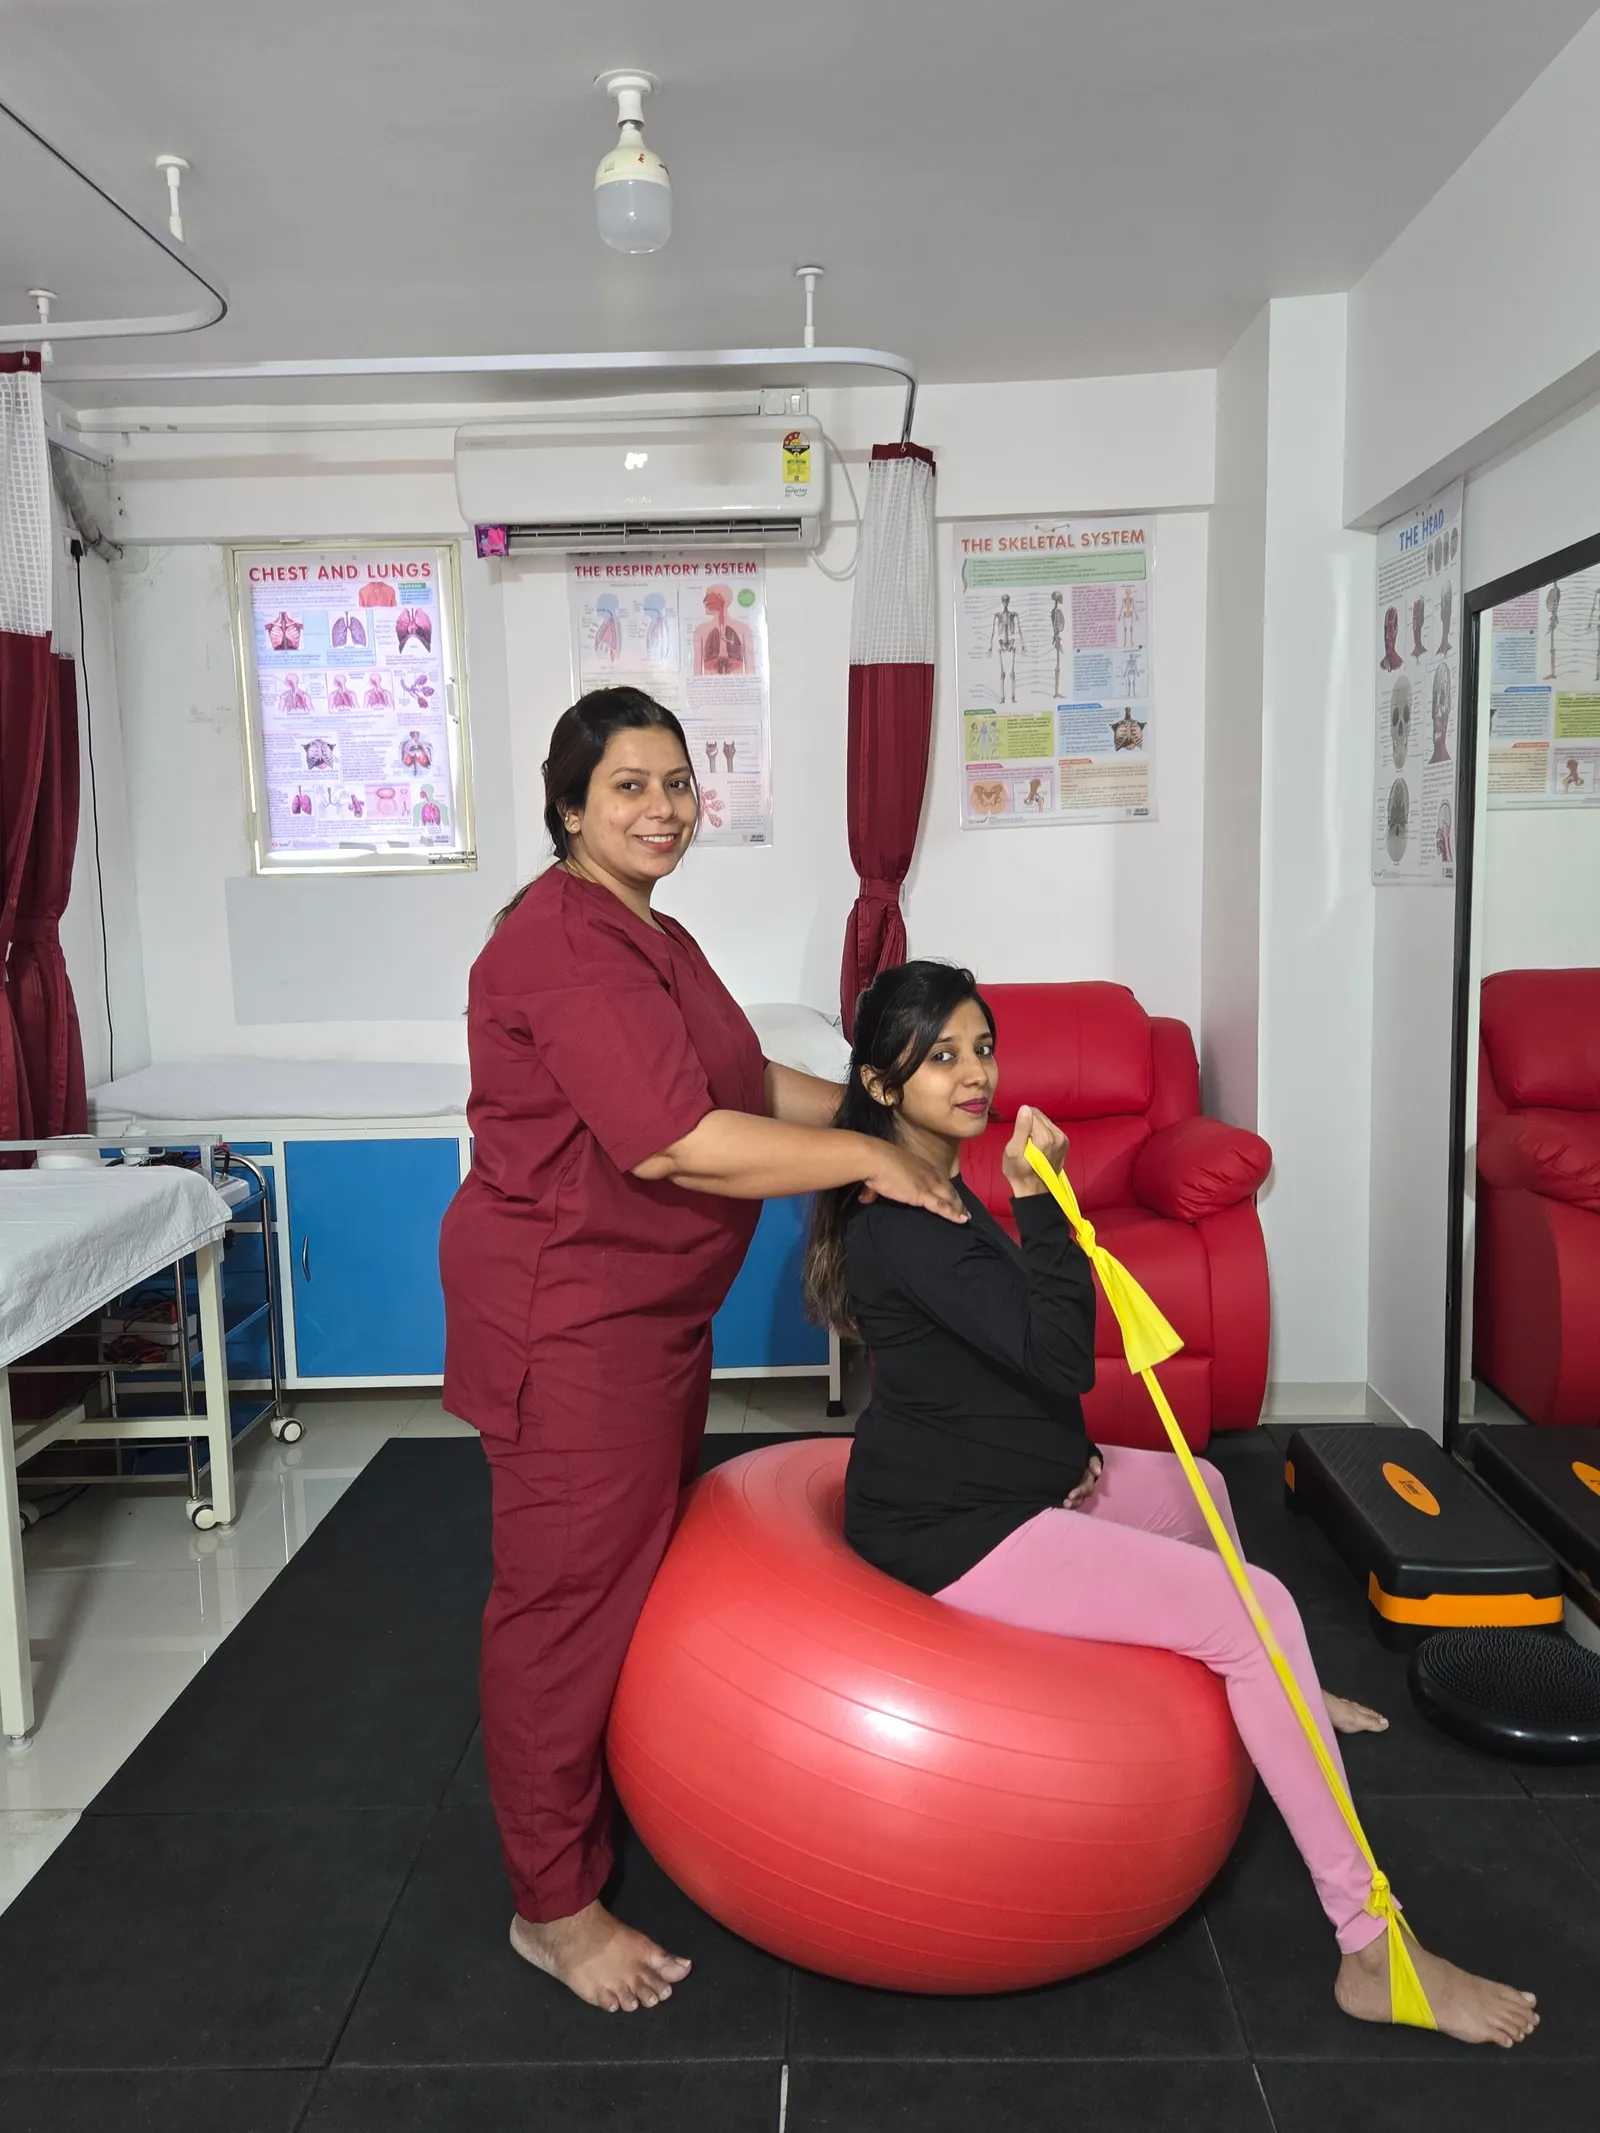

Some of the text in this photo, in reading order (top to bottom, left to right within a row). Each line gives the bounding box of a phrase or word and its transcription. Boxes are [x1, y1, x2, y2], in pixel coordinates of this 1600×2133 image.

[1399, 508, 1444, 551] THE HEAD
[961, 529, 1145, 553] THE SKELETAL SYSTEM
[249, 562, 432, 582] CHEST AND LUNGS
[575, 561, 757, 577] THE RESPIRATORY SYSTEM
